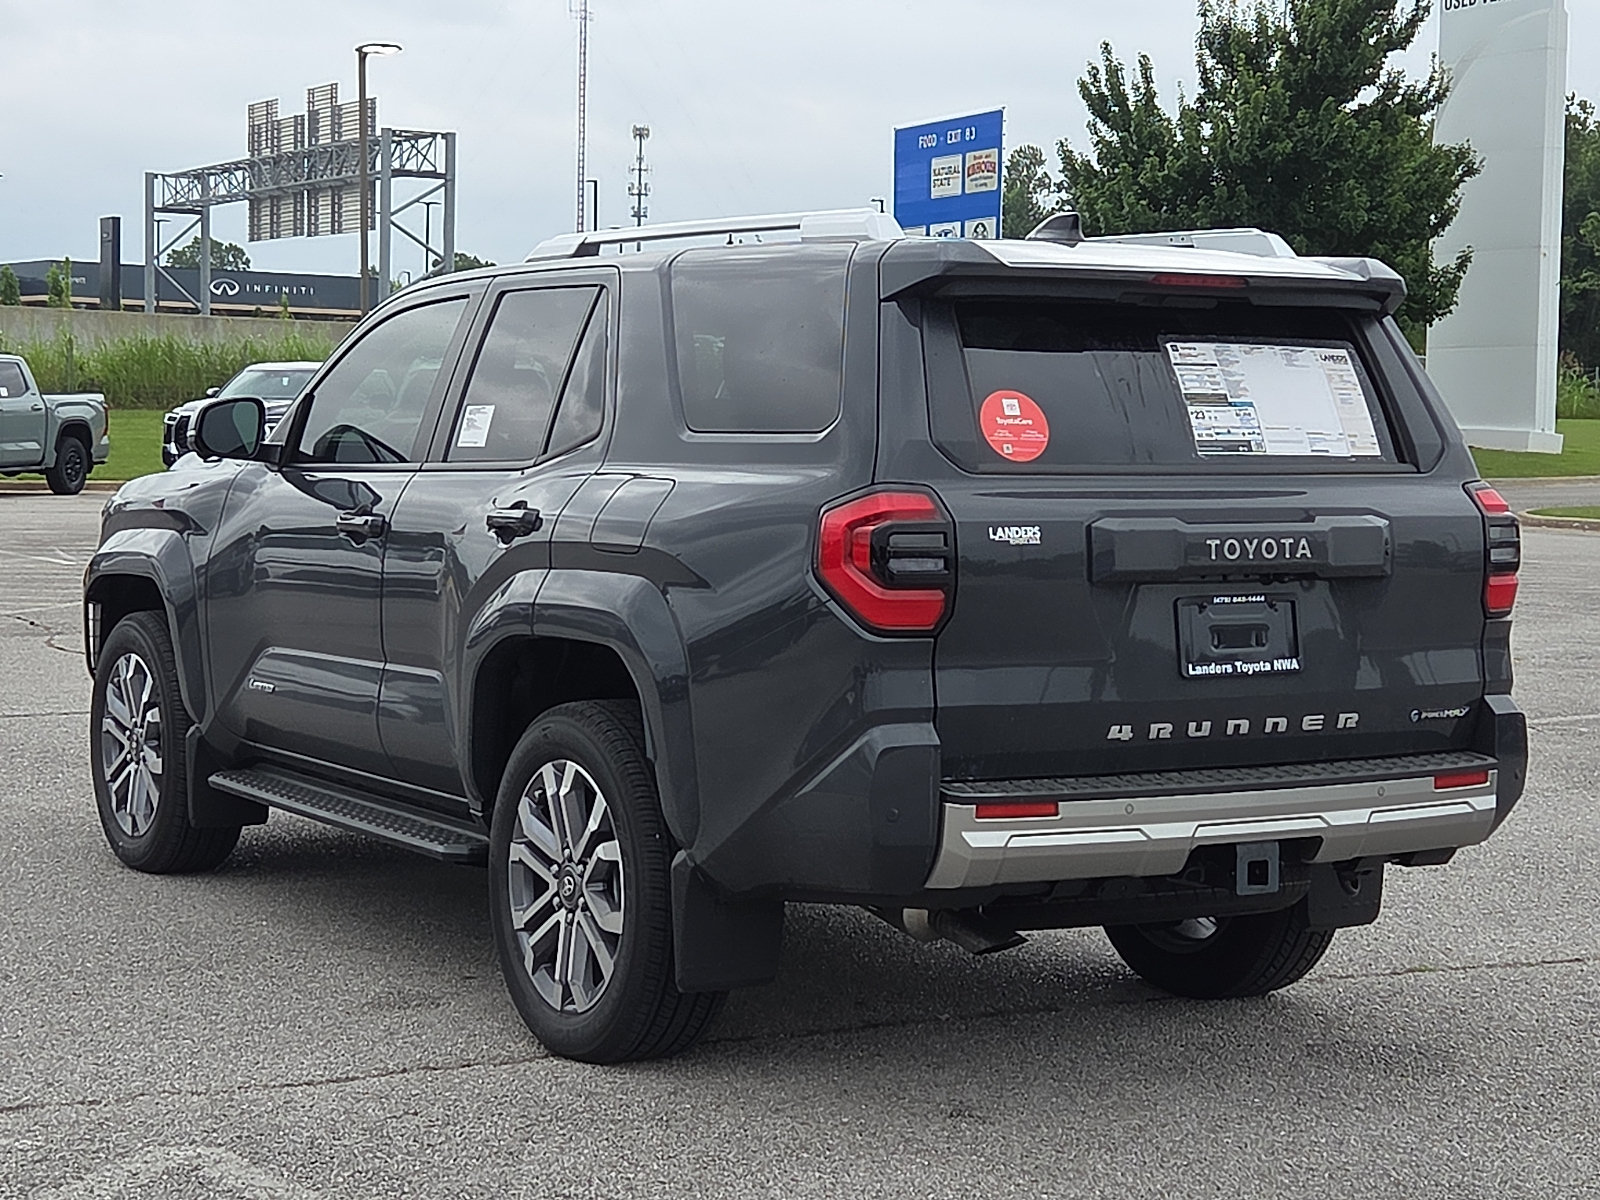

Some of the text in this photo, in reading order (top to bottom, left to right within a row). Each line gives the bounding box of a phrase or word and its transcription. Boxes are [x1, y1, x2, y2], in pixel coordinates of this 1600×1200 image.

[919, 133, 937, 149] FOOD
[947, 129, 961, 144] EXIT
[932, 177, 951, 189] STATE
[246, 283, 314, 296] INFINITI
[988, 526, 1041, 540] LANDERS
[1206, 537, 1312, 561] TOYOTA
[1188, 658, 1300, 676] Landers Toyota NWA
